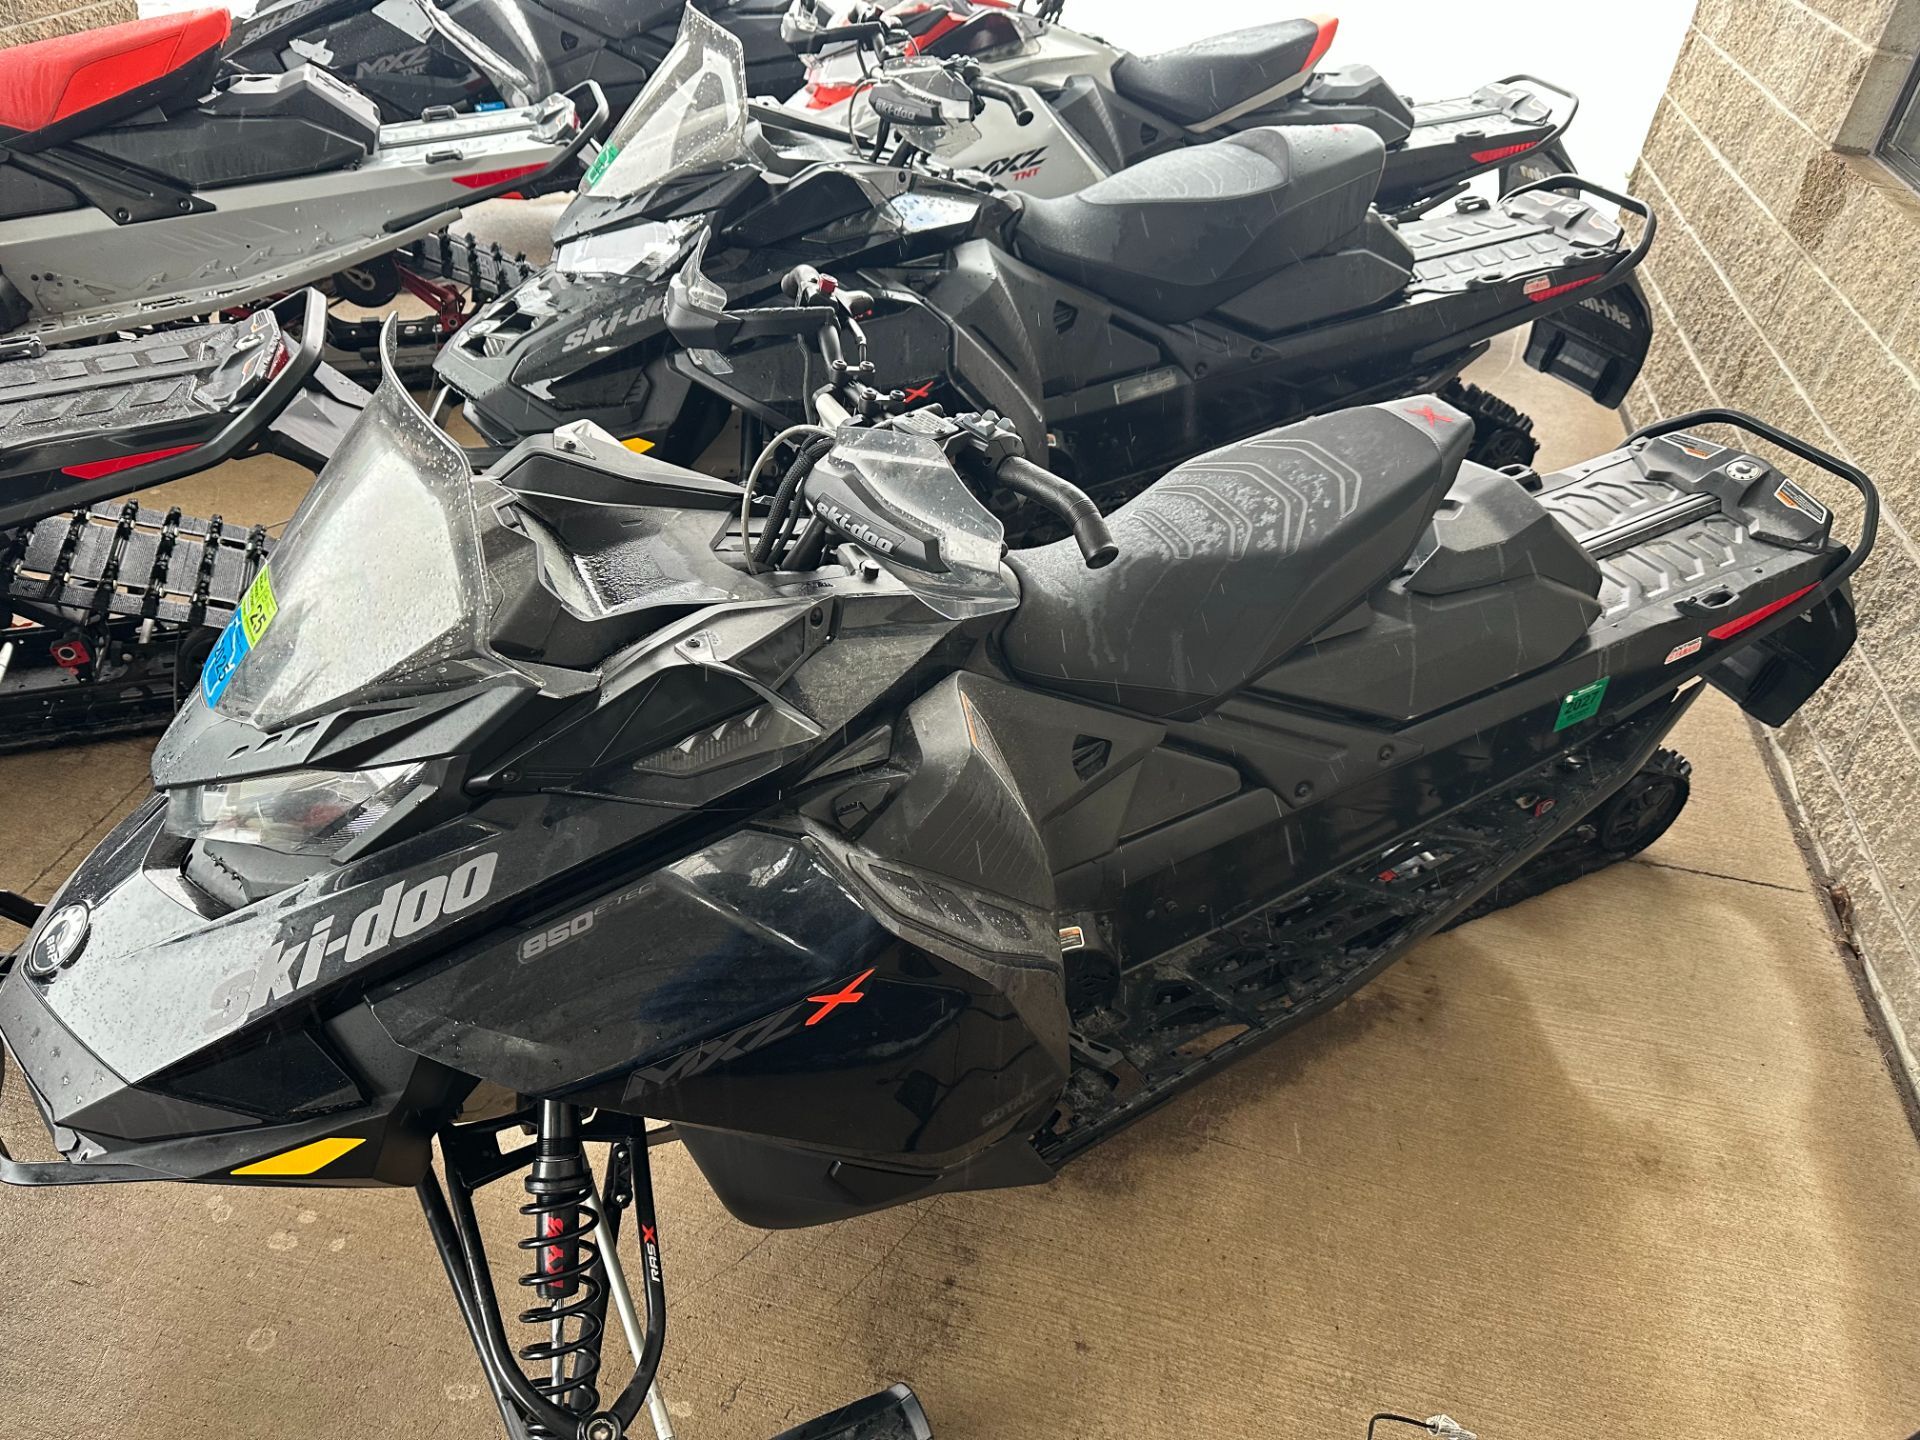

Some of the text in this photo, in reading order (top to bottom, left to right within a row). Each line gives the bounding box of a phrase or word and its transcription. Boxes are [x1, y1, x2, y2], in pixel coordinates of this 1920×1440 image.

[356, 45, 429, 78] MXZ
[400, 64, 427, 76] TNT
[1013, 167, 1041, 181] TNT
[561, 296, 664, 352] ski-do
[817, 502, 894, 553] ski-doo
[250, 604, 268, 634] 25
[1564, 691, 1599, 714] 2027
[46, 934, 59, 962] BRP
[203, 852, 498, 1035] ski-doo
[523, 910, 594, 959] 850
[545, 1216, 564, 1289] KYB
[647, 1243, 661, 1282] RAS
